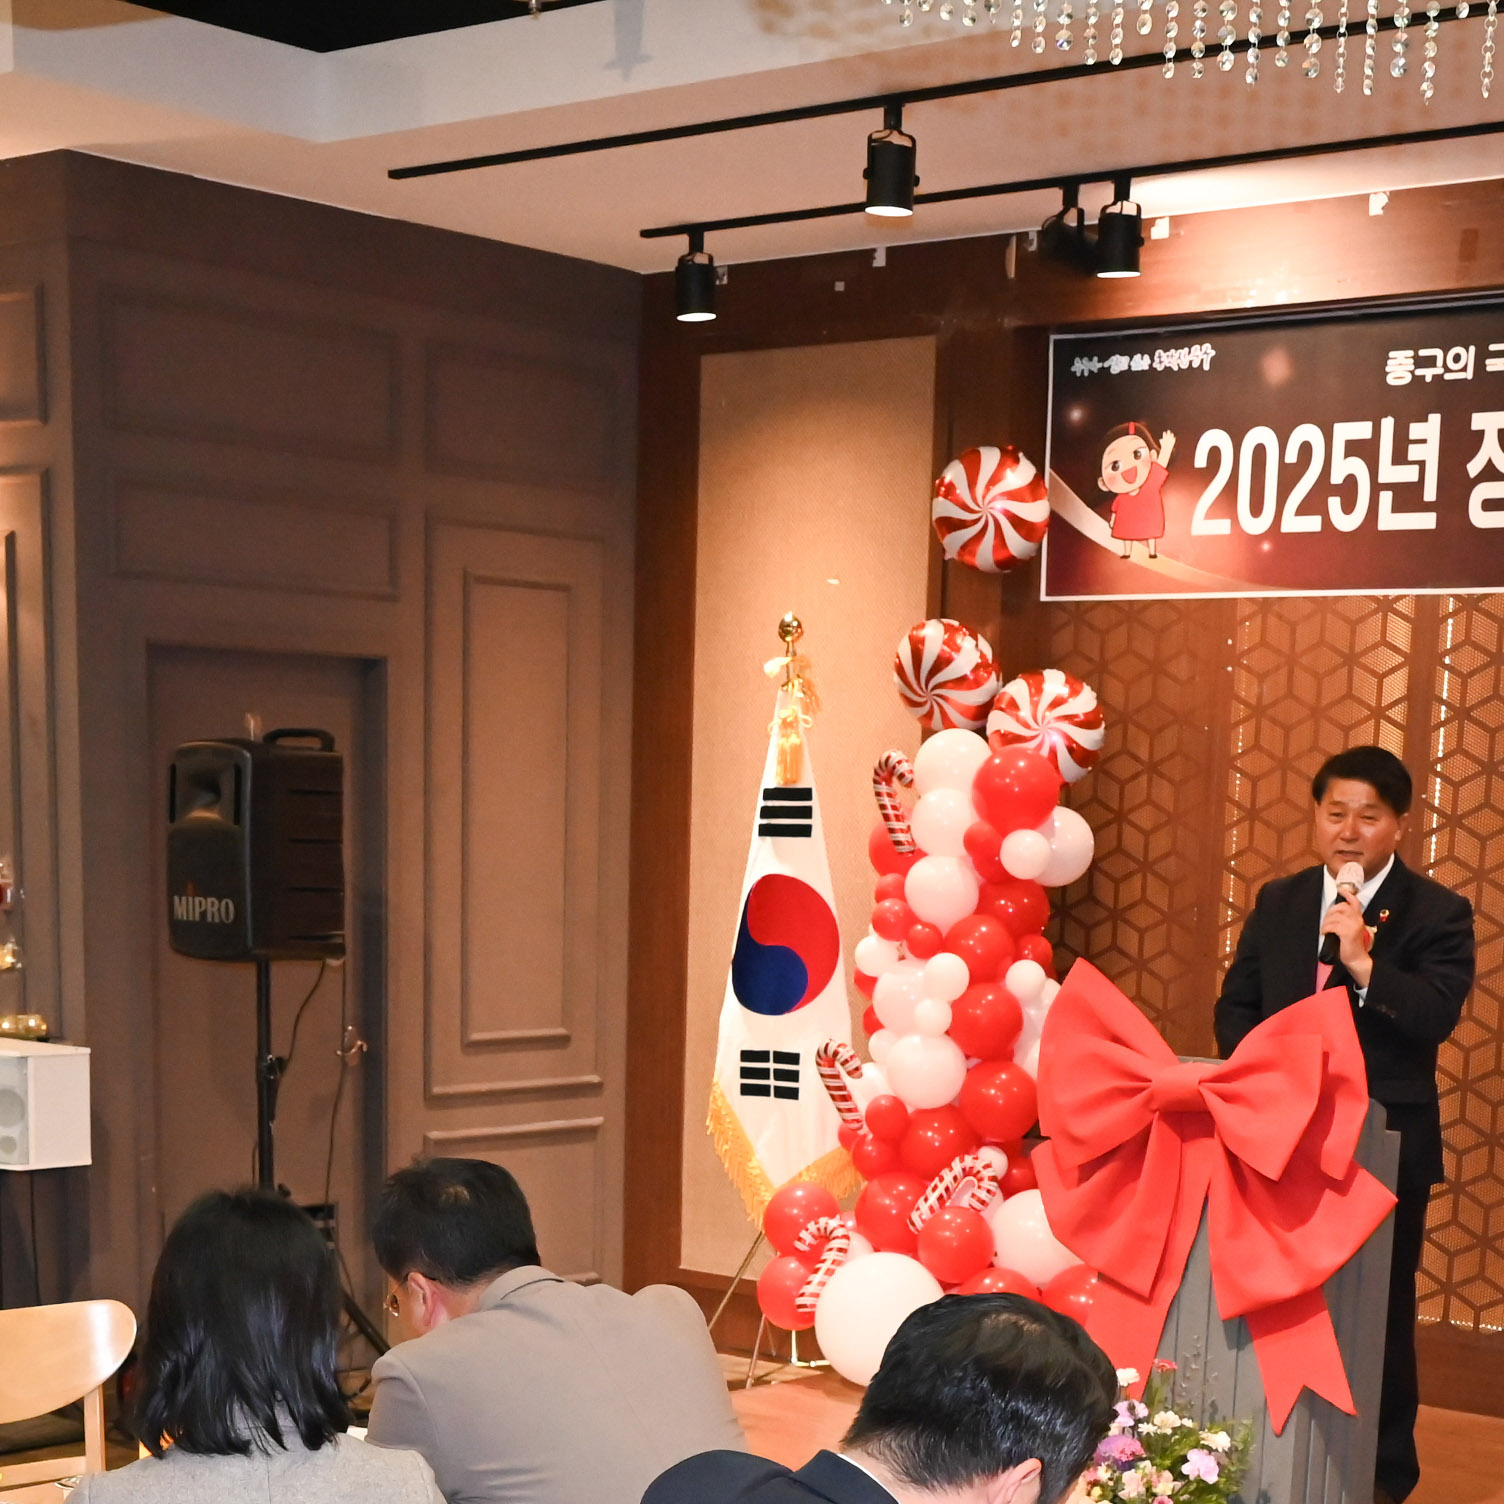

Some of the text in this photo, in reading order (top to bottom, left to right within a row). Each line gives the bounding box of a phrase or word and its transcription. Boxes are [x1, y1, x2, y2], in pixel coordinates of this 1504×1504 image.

[1384, 345, 1476, 386] 중구의
[1190, 413, 1442, 537] 2025년
[173, 895, 235, 923] MIPRO
